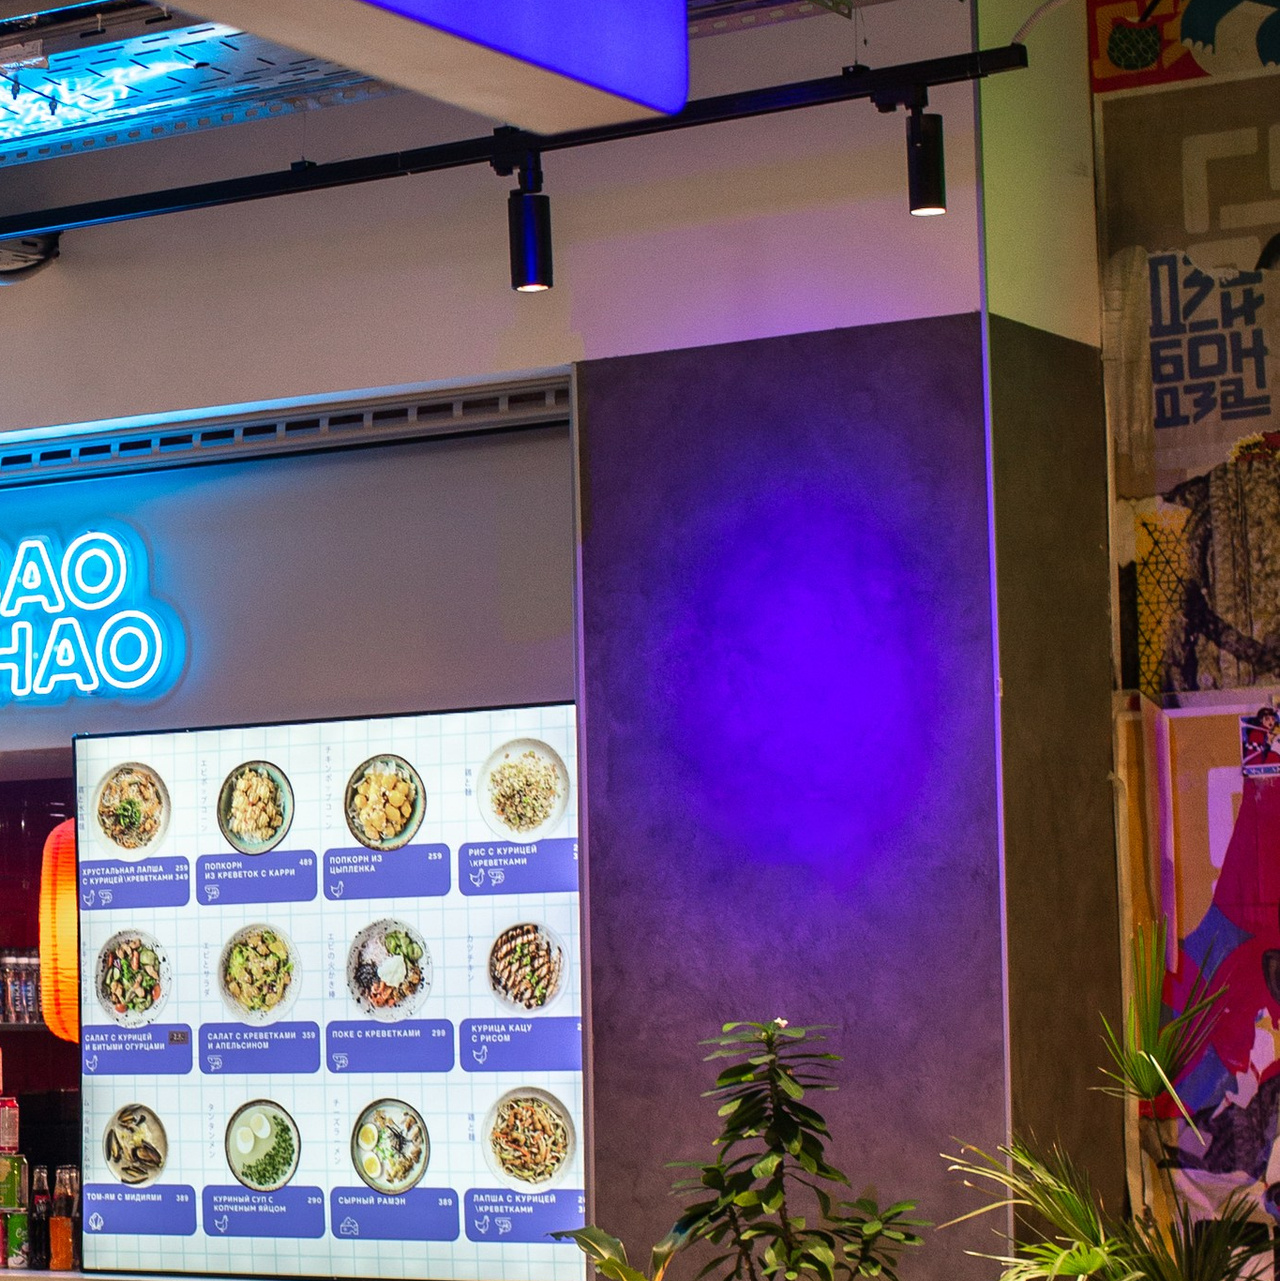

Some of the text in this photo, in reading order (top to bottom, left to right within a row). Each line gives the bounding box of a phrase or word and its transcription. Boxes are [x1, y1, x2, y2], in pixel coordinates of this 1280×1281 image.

[469, 844, 538, 857] РИС С КУРИЦЕЙ
[330, 852, 443, 865] ПОПКОРН ИЗ 259
[205, 858, 313, 870] ПОПКОРН 489
[330, 864, 376, 874] ЦЫПЛЕНКА
[82, 864, 189, 876] ХРУСТАЛЬНАЯ ЛАПША 259
[205, 868, 295, 880] ИЗ КРЕВЕТОК С КАРРИ
[82, 877, 88, 885] С
[174, 873, 189, 881] 349
[332, 1029, 446, 1038] ПОКЕ С КРЕВЕТКАМИ 299
[471, 1024, 532, 1034] КУРИЦА КАЦУ
[85, 1031, 153, 1042] САЛАТ С КУРИЦЕЙ
[207, 1031, 316, 1041] САЛАТ С КРЕВЕТКАМИ 359
[471, 1034, 511, 1043] С РИСОМ
[85, 1042, 165, 1052] И БИТЫМИ ОГУРЦАМИ
[208, 1041, 269, 1050] И АПЕЛЬСИНОМ
[86, 1193, 189, 1202] ТОМ-ЯМ С МИДИЯМИ 389
[213, 1194, 322, 1204] КУРИНЫЙ СУП С 290
[338, 1195, 453, 1206] СЫРНЫЙ РАМЭН 389
[473, 1194, 556, 1204] ЛАПША С КУРИЦЕЙ
[213, 1204, 286, 1213] КОПЧЕНЫМ ЯЙЦОМ
